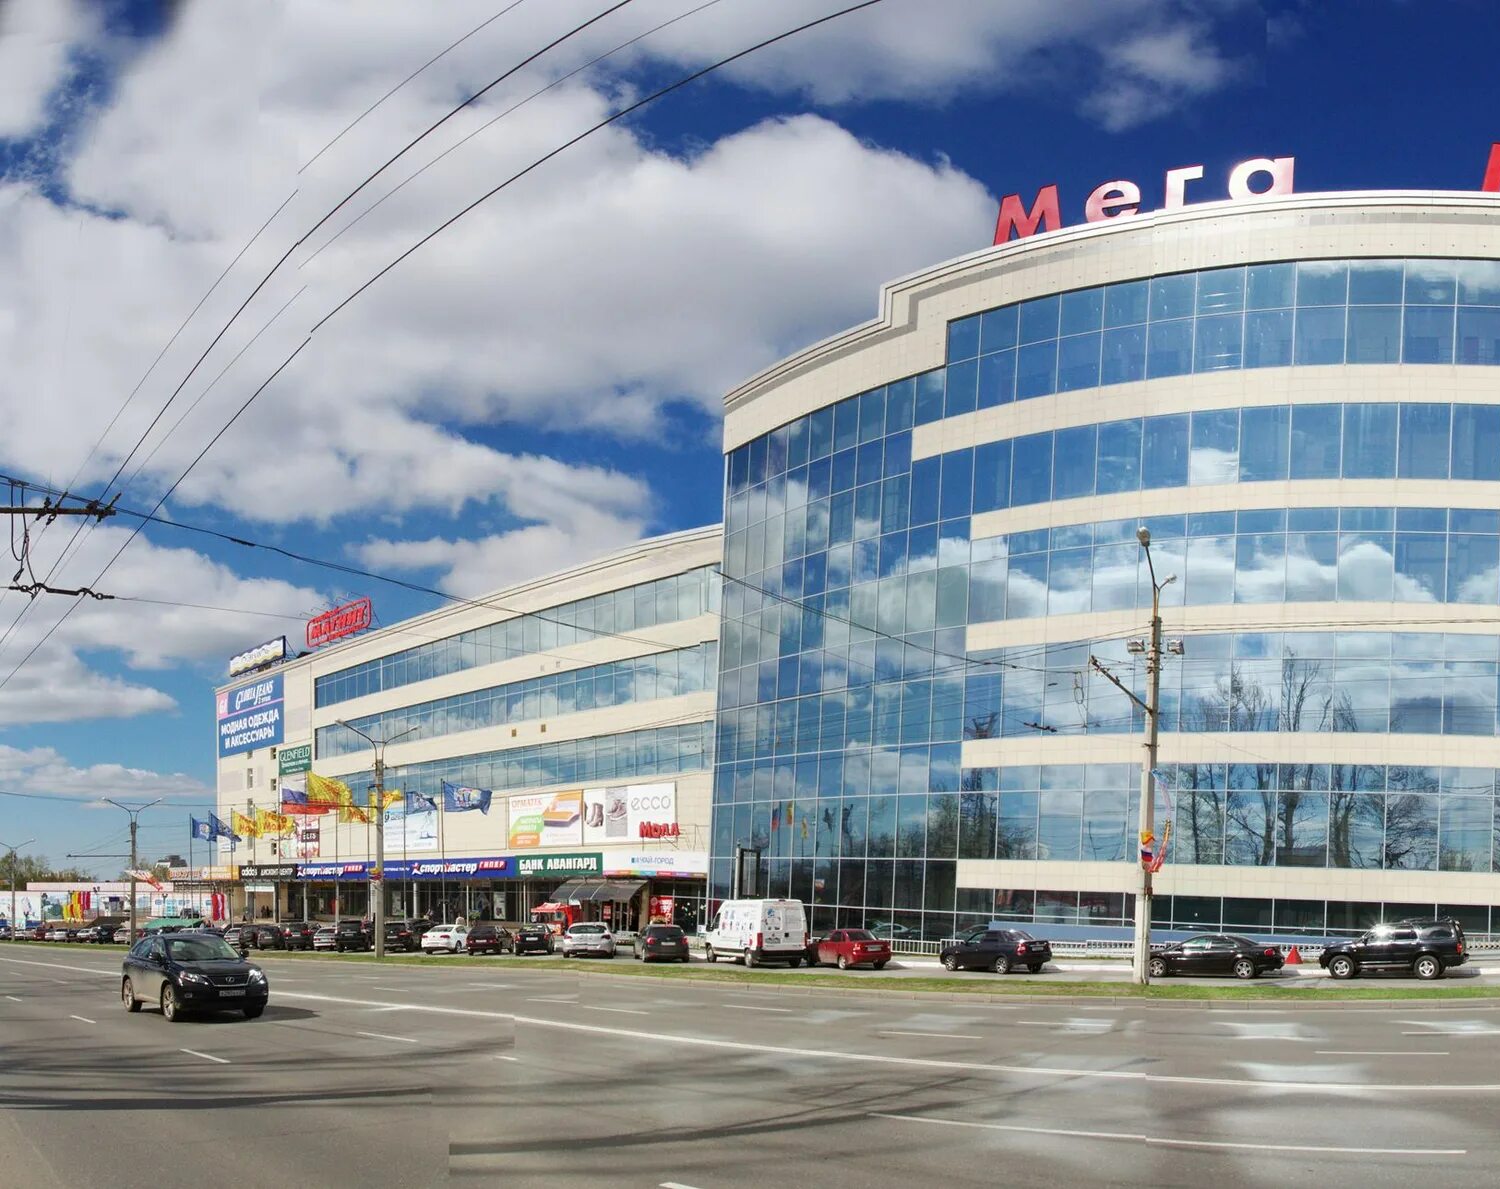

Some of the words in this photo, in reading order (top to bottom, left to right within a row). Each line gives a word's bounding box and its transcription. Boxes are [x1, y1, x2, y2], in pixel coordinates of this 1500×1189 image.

[248, 708, 280, 728] ОДЕЖДА
[230, 725, 275, 747] АКСЕССУАРЫ
[280, 746, 310, 762] GLENFIELD
[630, 795, 671, 811] ecco
[519, 859, 543, 871] БАНК
[547, 857, 597, 870] АВАНГАРД
